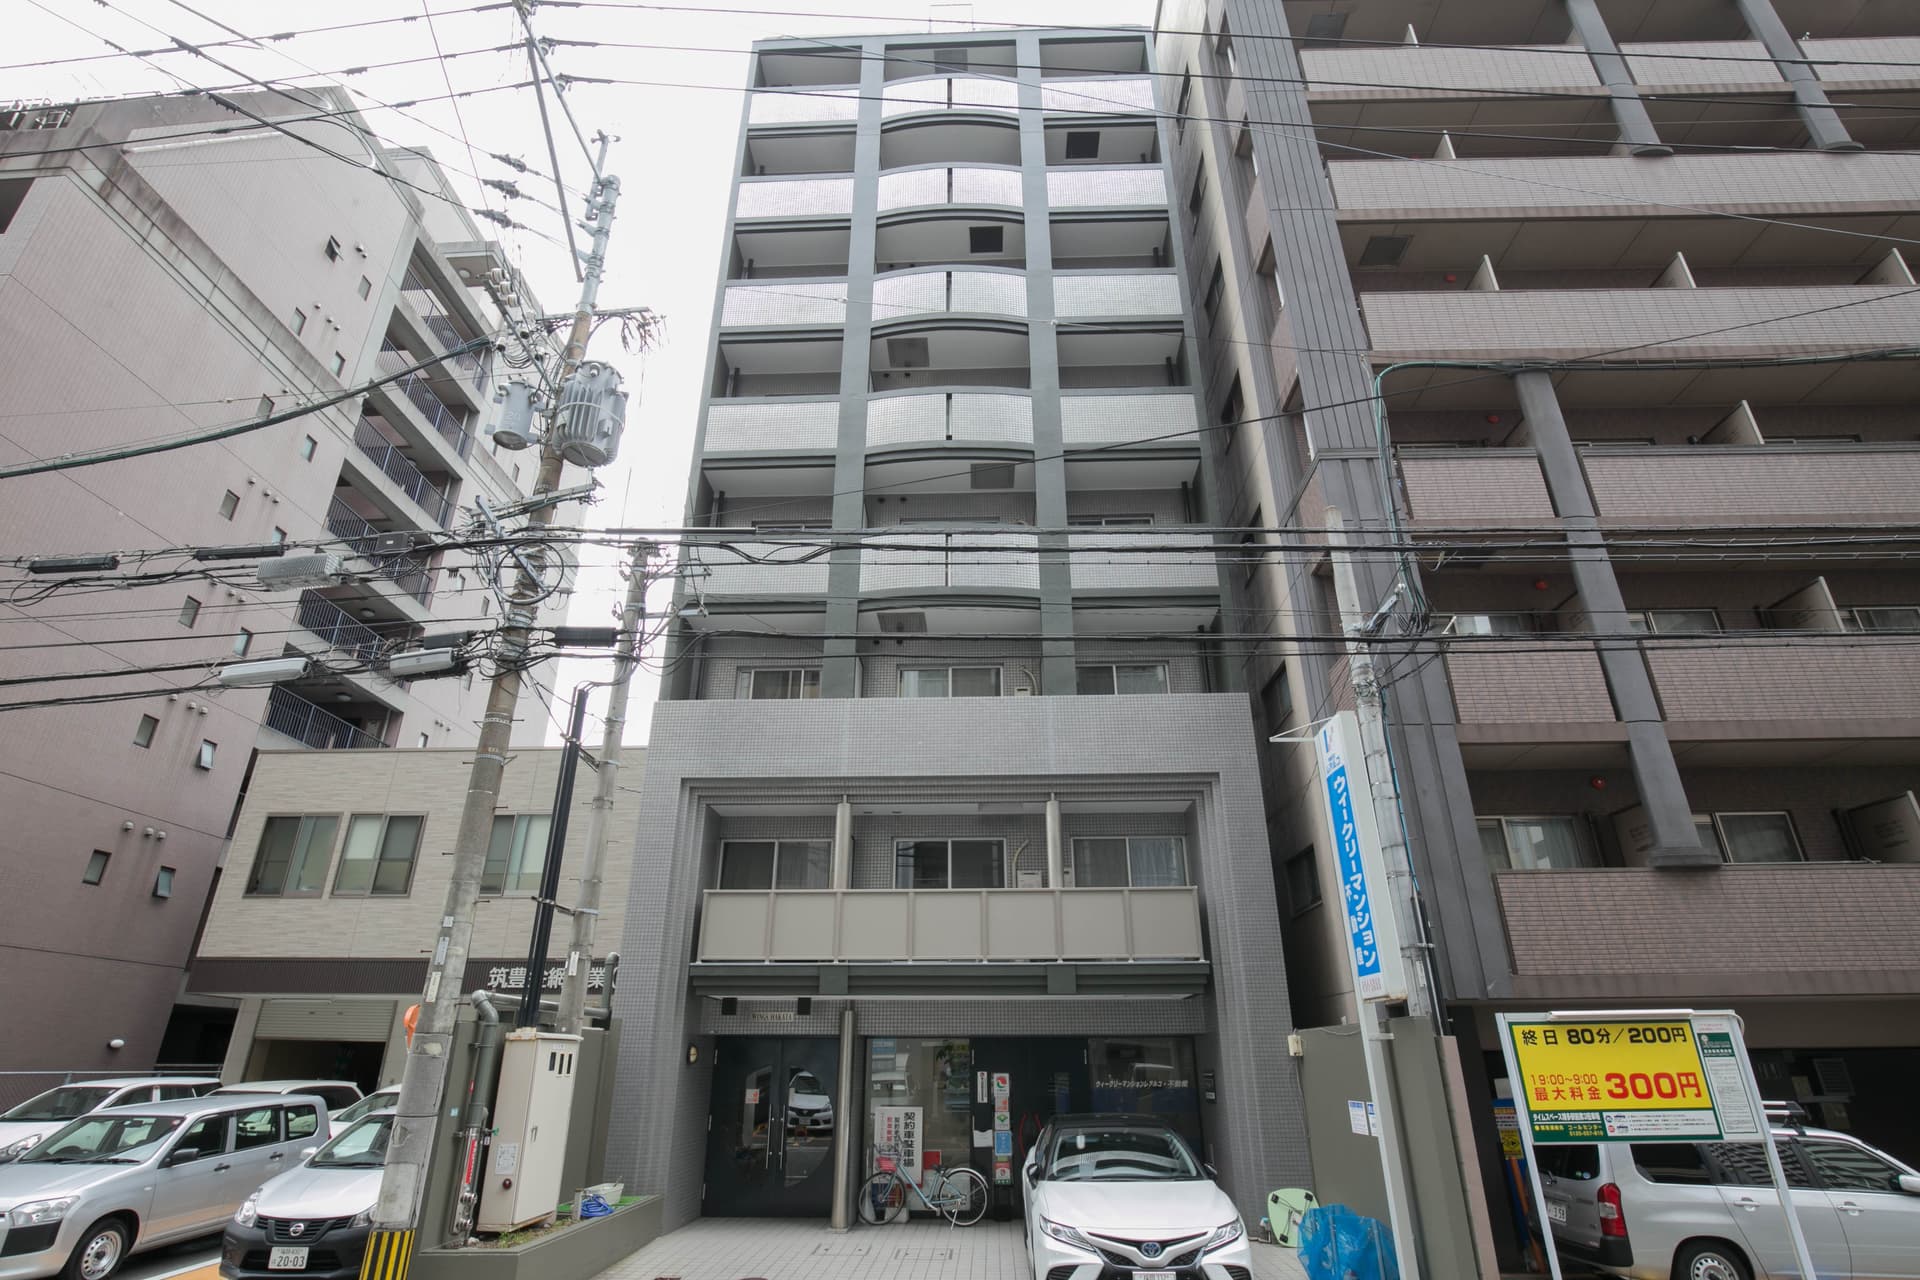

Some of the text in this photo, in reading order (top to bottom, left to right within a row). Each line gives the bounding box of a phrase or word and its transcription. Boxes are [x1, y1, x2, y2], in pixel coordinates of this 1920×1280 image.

[1332, 774, 1377, 968] ウィークリーマンション
[1521, 1029, 1559, 1046] 終日
[1534, 1071, 1702, 1102] 最大料金 300円
[903, 1111, 916, 1168] 契約車駐車場
